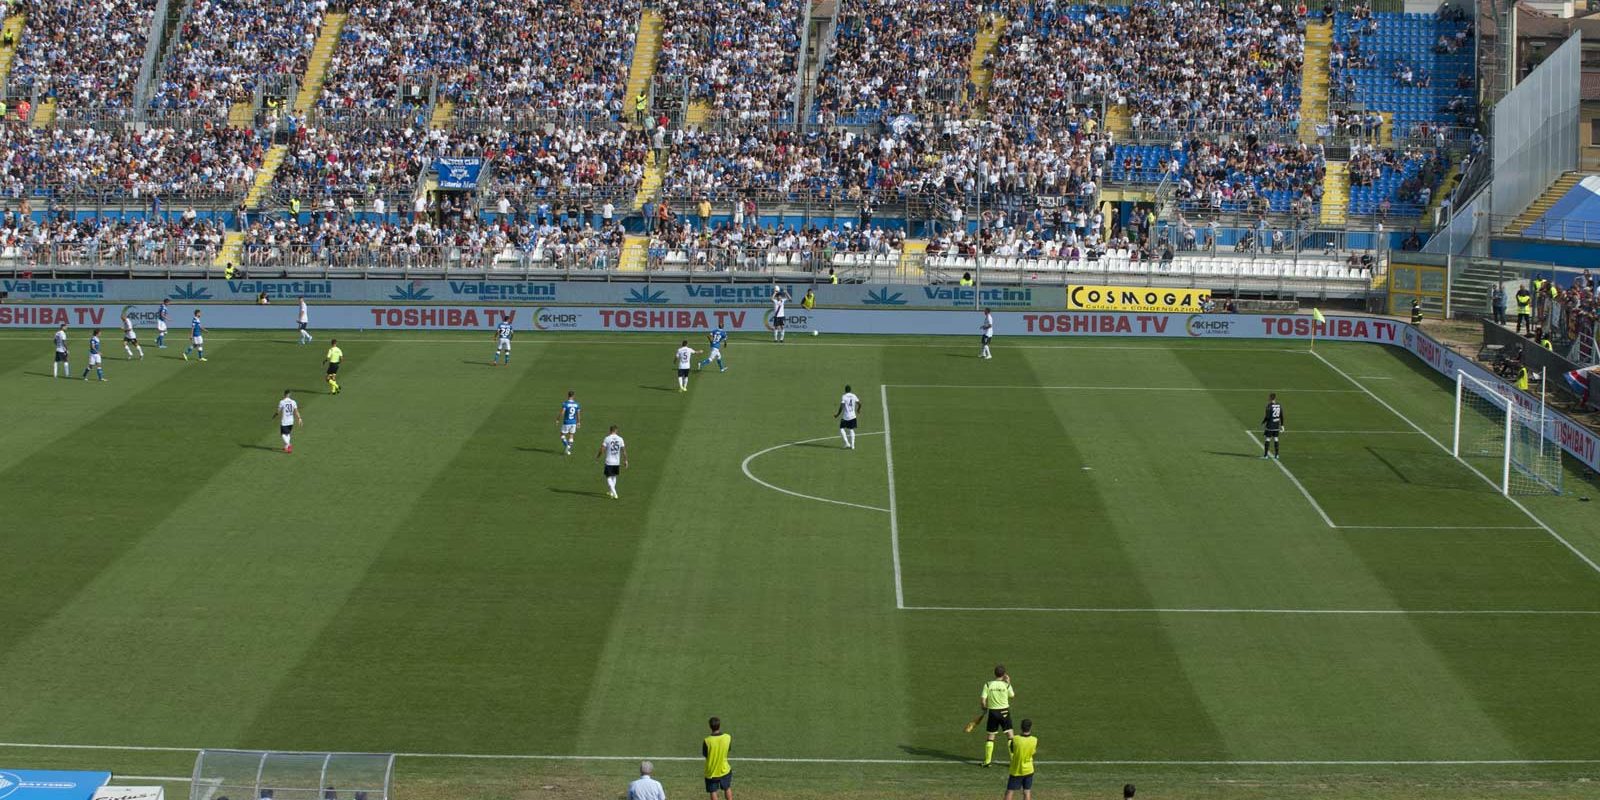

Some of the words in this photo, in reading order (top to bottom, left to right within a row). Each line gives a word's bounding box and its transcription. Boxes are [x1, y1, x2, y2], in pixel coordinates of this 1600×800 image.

[3, 280, 103, 293] Valentini
[227, 281, 332, 293] Valentini
[449, 282, 556, 295] Valentini
[685, 284, 793, 298] Valentii
[923, 286, 1032, 301] Valentini
[1071, 286, 1207, 307] COSMOGAS
[74, 307, 105, 325] TV
[371, 308, 479, 327] TOSHIBA
[483, 309, 517, 327] TV
[599, 309, 709, 328] TOSHIBA
[713, 310, 747, 328] TV
[1023, 314, 1132, 334] TOSHIBA
[1136, 315, 1169, 334] TV
[1262, 317, 1369, 338] TOSHIBA
[1373, 321, 1397, 341] TV
